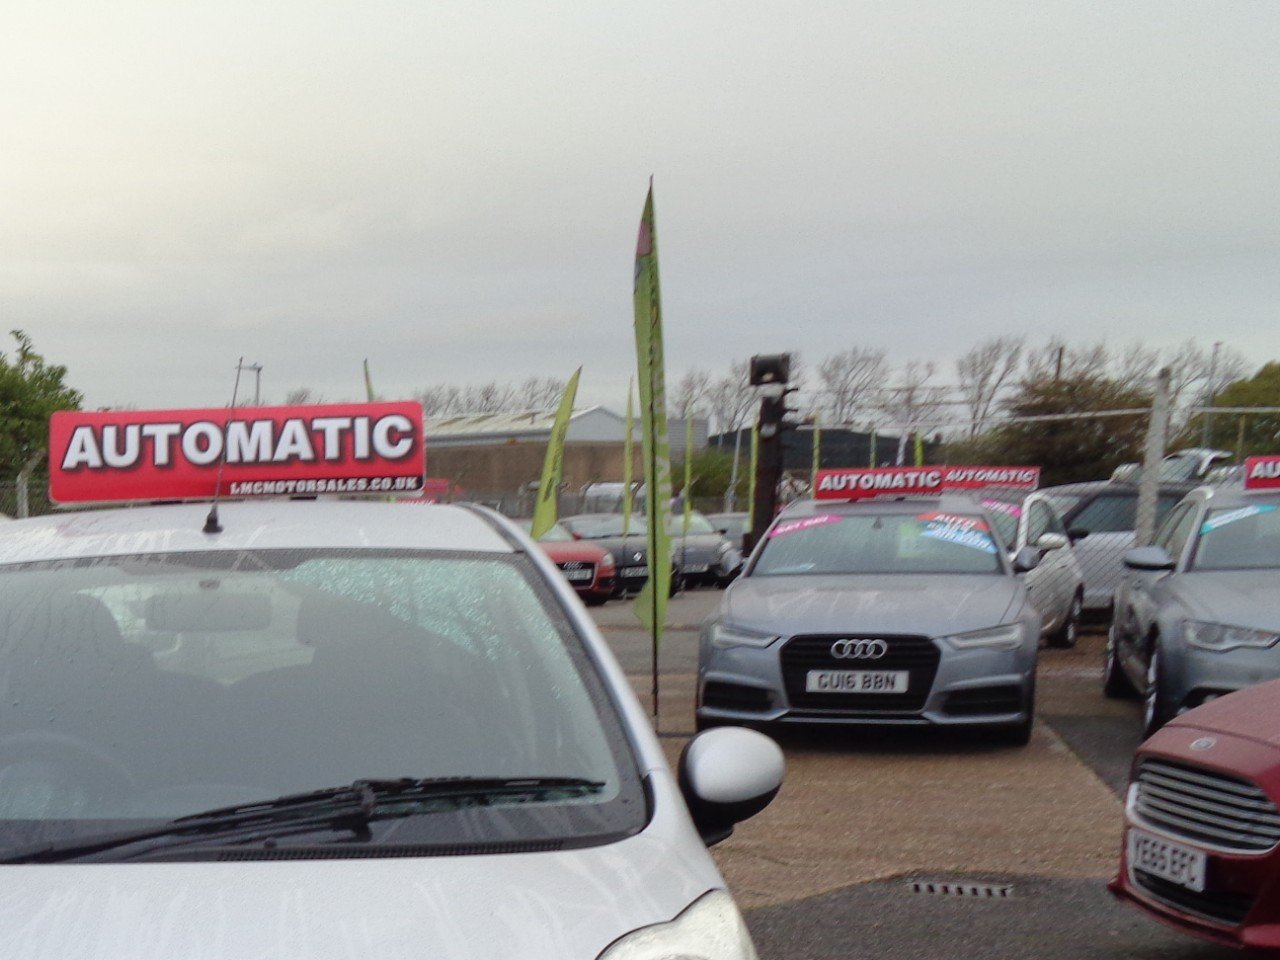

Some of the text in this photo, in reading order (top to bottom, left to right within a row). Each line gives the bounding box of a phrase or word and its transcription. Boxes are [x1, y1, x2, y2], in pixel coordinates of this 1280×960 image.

[61, 413, 415, 470] AUTOMATIC
[820, 471, 942, 490] AUTOMATIC
[945, 468, 1036, 483] AUTOMATIC
[229, 476, 419, 496] LMCMOTORSALES.CO.UK
[818, 673, 896, 690] GU16 BBN
